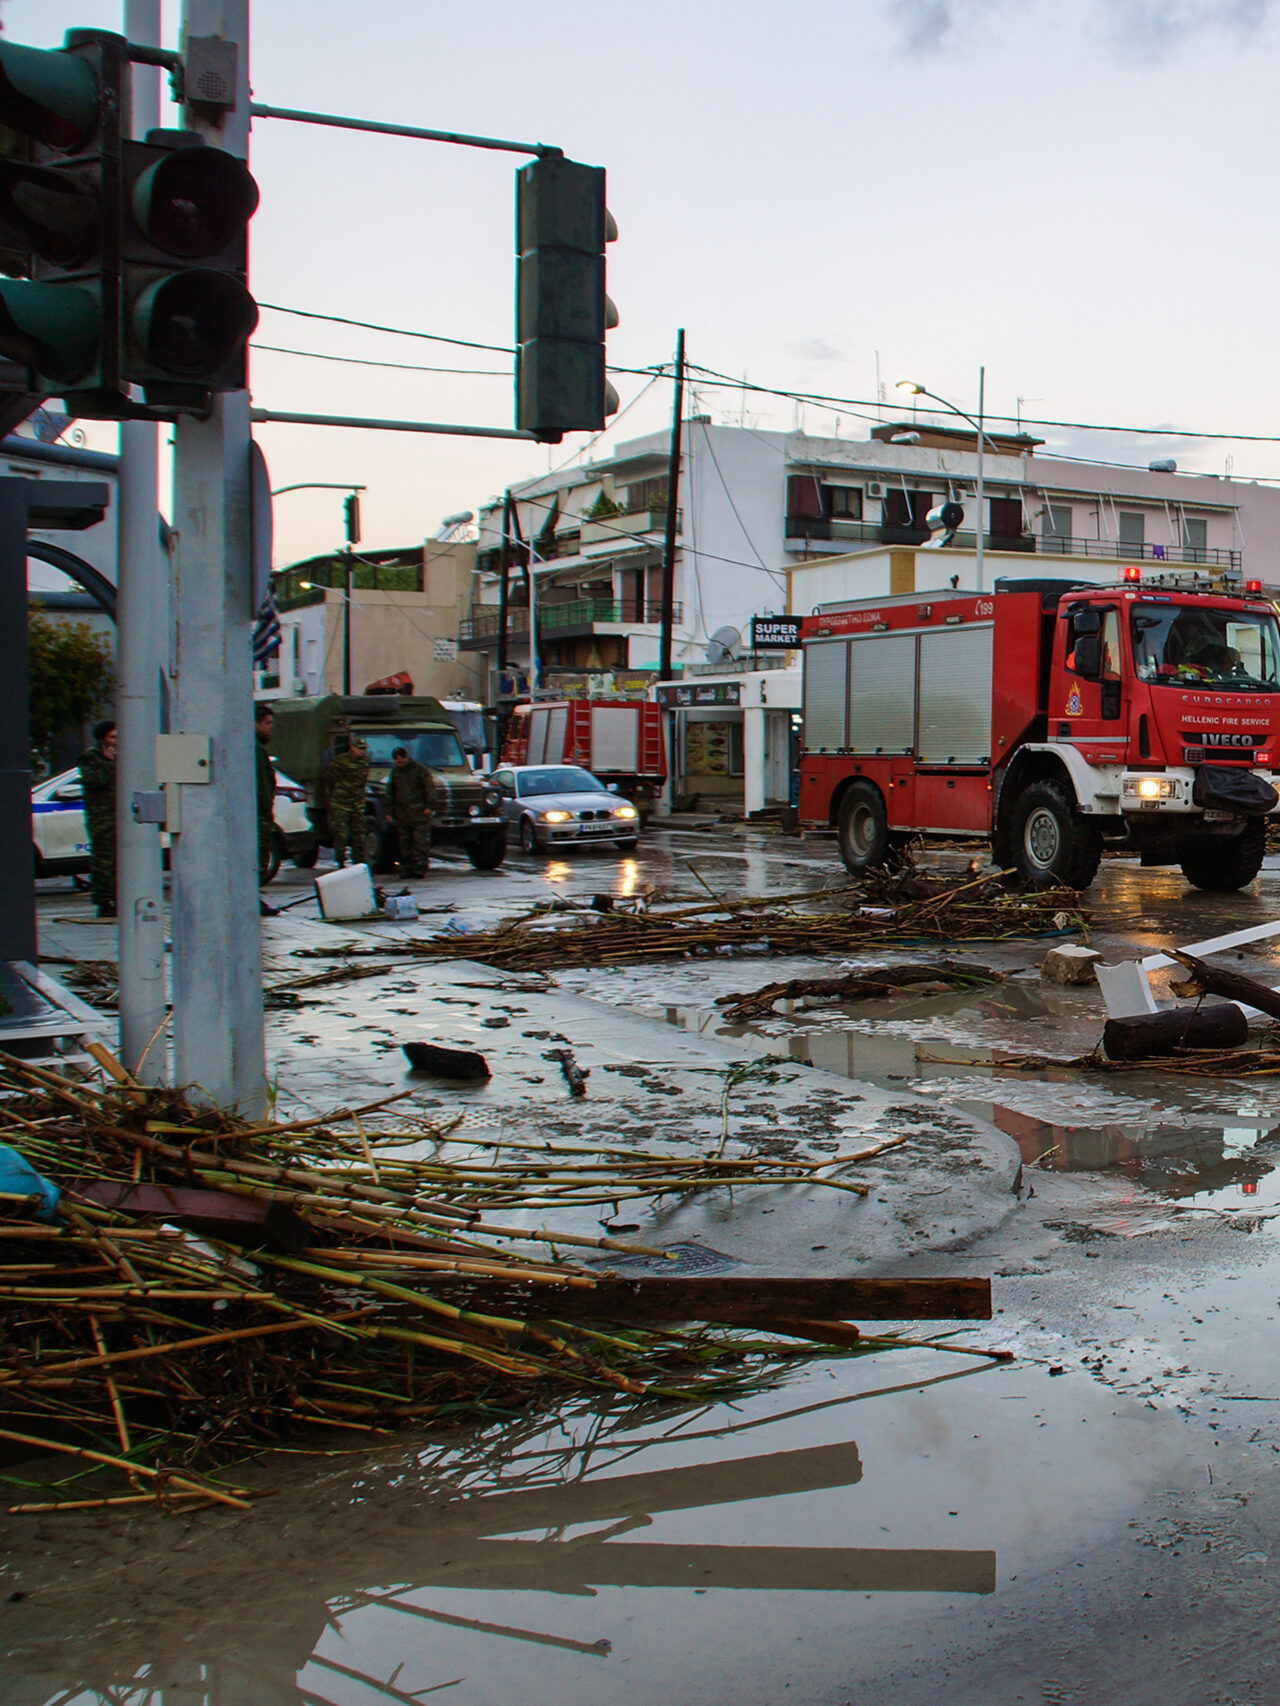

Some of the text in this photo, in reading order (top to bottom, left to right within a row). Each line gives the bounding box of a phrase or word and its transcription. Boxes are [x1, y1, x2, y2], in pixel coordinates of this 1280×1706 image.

[980, 602, 993, 615] 199
[755, 623, 798, 635] SUPER
[755, 634, 798, 644] MARKET
[1182, 695, 1271, 706] EUROCARGO
[1181, 715, 1270, 726] HELLENIC FIRE SERVICE
[1202, 733, 1254, 747] IVECO
